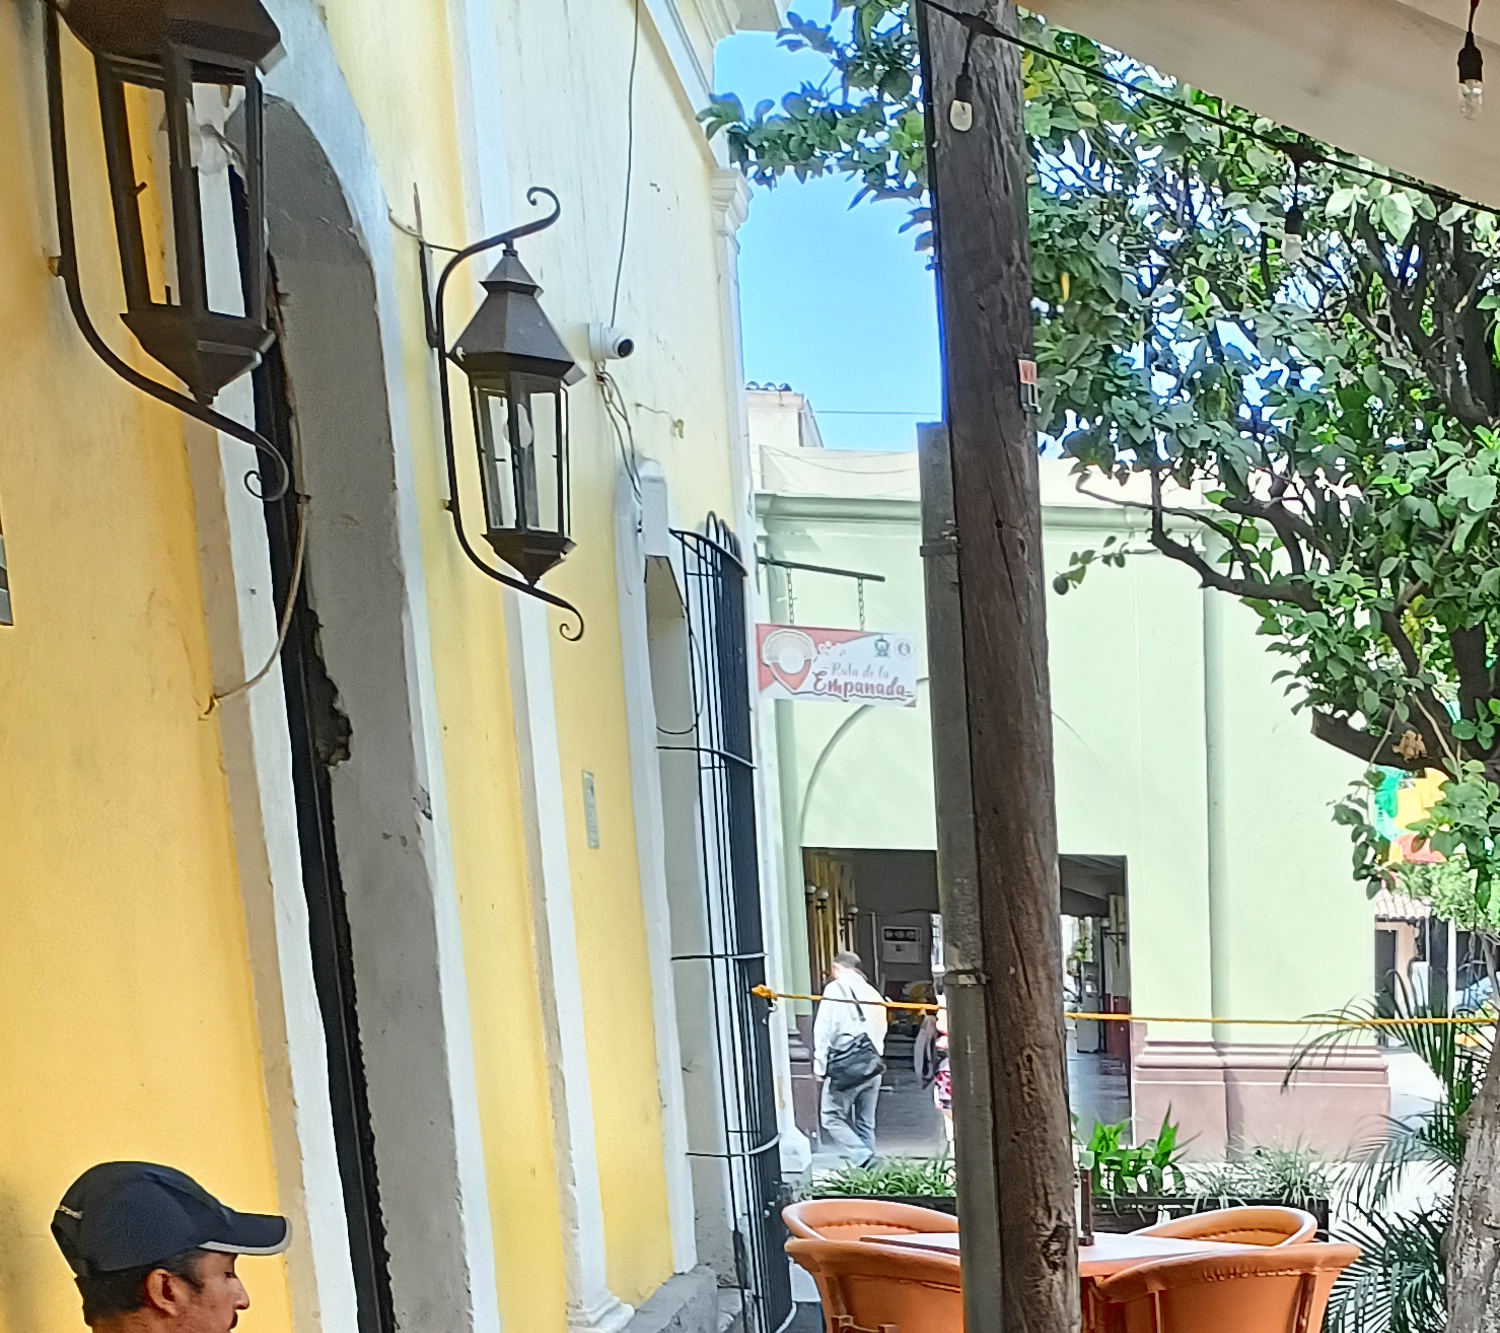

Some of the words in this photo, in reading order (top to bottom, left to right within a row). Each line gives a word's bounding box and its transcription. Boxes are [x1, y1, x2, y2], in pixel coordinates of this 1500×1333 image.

[862, 664, 874, 678] de
[878, 665, 890, 679] la
[812, 670, 905, 698] Empanada
